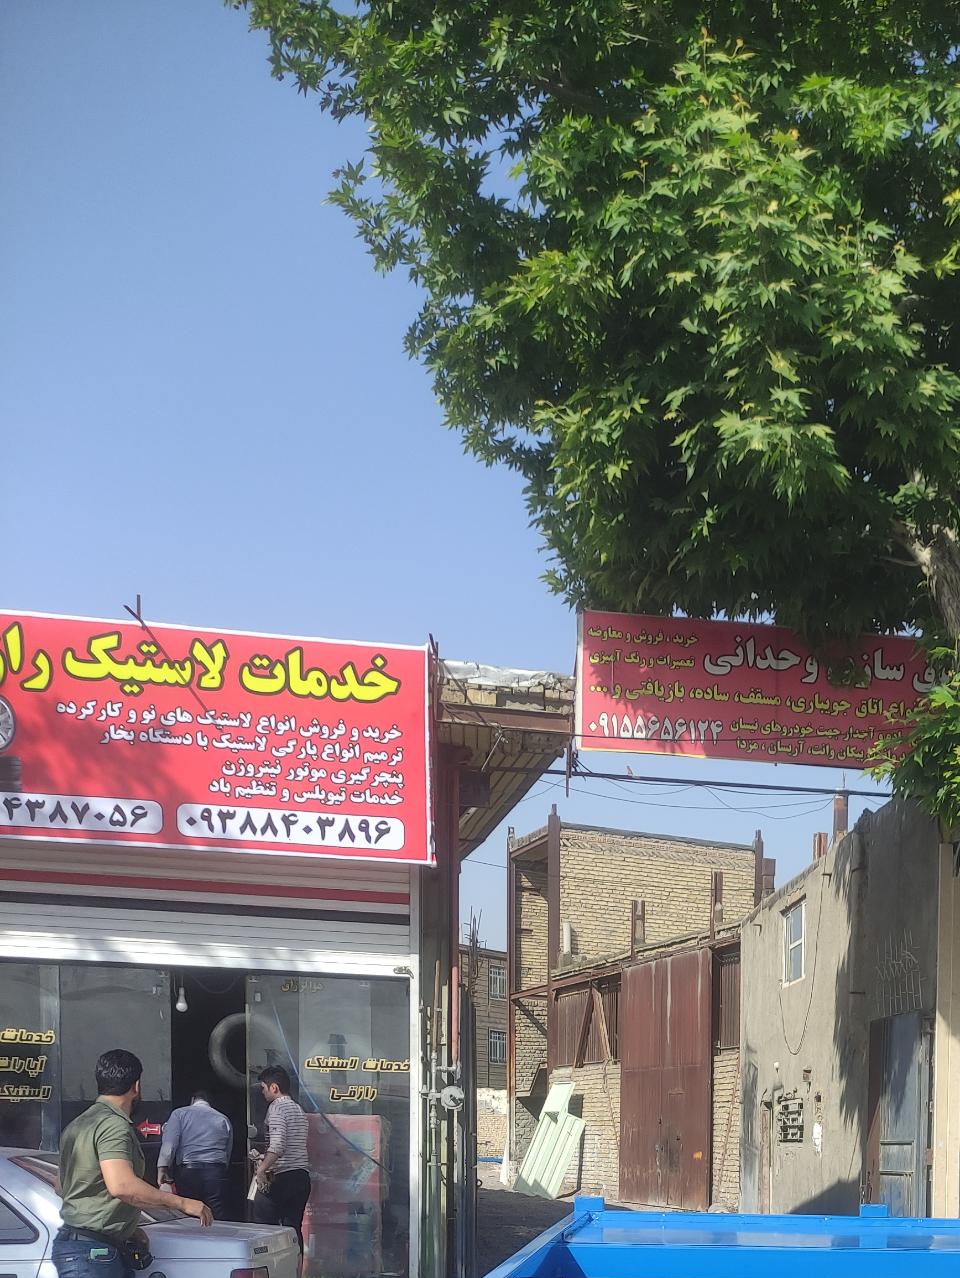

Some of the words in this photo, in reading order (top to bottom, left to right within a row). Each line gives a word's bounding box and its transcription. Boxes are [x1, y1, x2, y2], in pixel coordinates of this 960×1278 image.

[587, 625, 623, 641] معاوضه
[625, 631, 632, 643] و
[633, 629, 665, 646] فروش
[672, 633, 700, 648] خرید
[62, 631, 229, 696] لاستیک
[589, 649, 622, 665] آمیزی
[624, 652, 647, 668] رنگ
[656, 656, 696, 669] تعمیرات
[703, 636, 819, 685] وحدانی
[239, 646, 402, 703] خدمات
[612, 682, 622, 699] و
[625, 679, 685, 702] بازیافتی
[127, 708, 138, 723] و
[140, 704, 157, 724] نو
[160, 707, 193, 726] های
[855, 697, 883, 718] اتاق
[196, 710, 252, 731] لاستیک
[256, 714, 297, 735] انواع
[299, 718, 347, 740] فروش
[588, 711, 723, 745] ۰۹۱۵۵۶۵۶۱۲۴
[730, 718, 759, 733] نیسان
[761, 719, 814, 737] خودروهای
[100, 723, 135, 745] بخار
[139, 727, 193, 745] دستگاه
[195, 731, 209, 751] با
[351, 726, 360, 741] و
[362, 723, 403, 743] خرید
[211, 734, 267, 753] لاستیک
[320, 743, 360, 762] انواع
[363, 747, 404, 766] ترمیم
[221, 757, 282, 778] نیتروژن
[285, 761, 327, 781] موتور
[208, 777, 232, 797] باد
[234, 779, 277, 799] تنظیم
[280, 787, 290, 802] و
[293, 784, 347, 805] تیوبلس
[349, 788, 405, 805] خدمات
[186, 807, 391, 845] ۰۹۳۸۸۴۰۳۸۹۶
[0, 1028, 55, 1044] خدمات
[305, 1056, 359, 1073] لاستیک
[362, 1058, 411, 1072] خدمات
